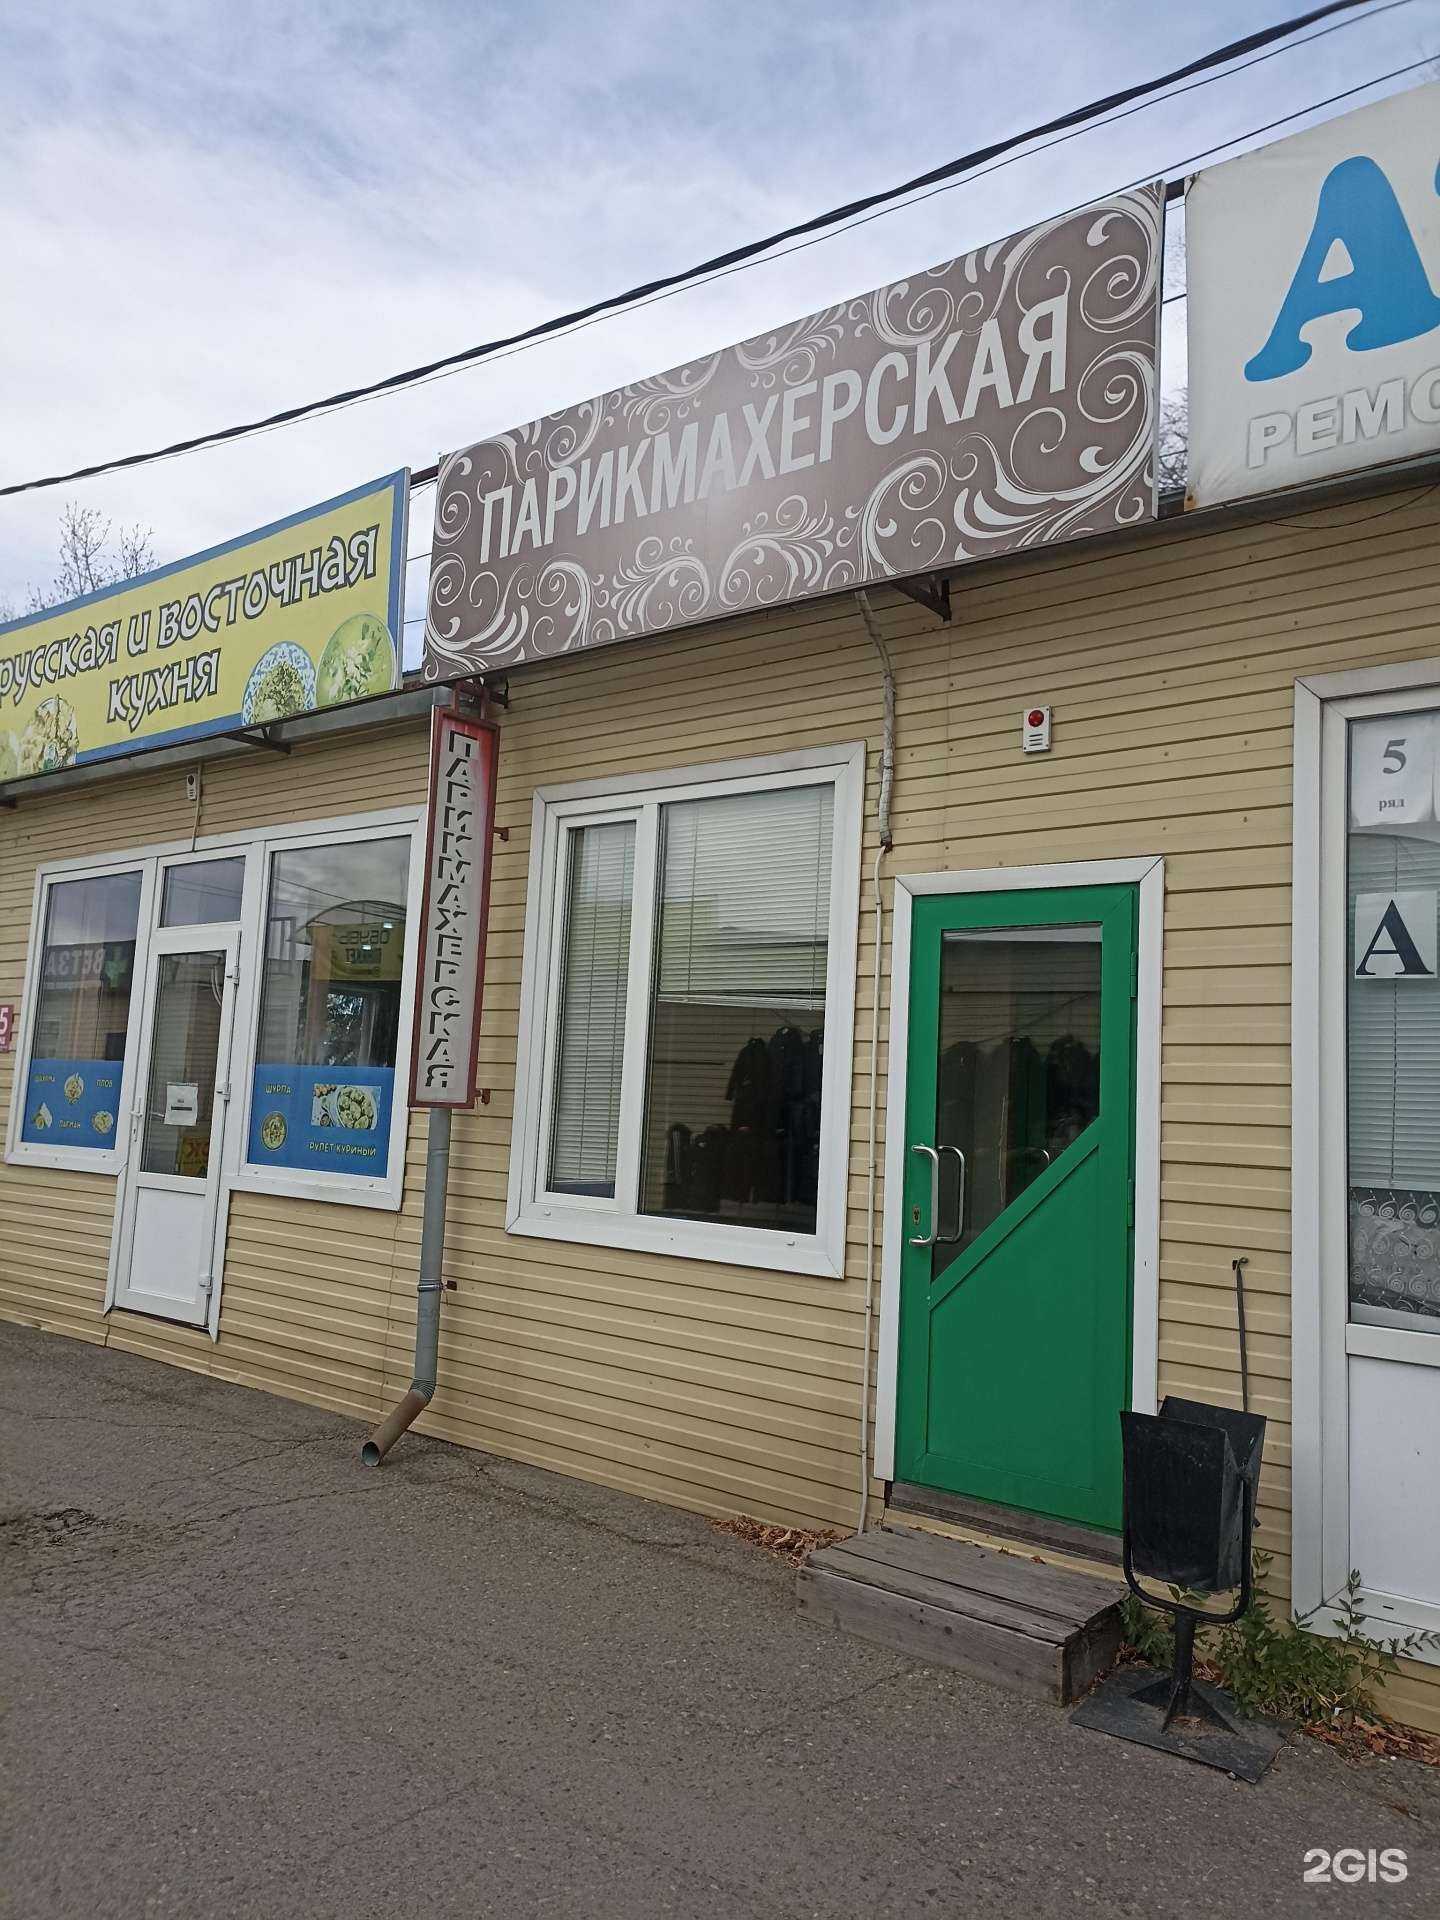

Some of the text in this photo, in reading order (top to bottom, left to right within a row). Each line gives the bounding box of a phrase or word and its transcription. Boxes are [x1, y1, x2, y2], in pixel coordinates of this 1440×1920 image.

[479, 295, 1069, 565] ПАРИКМАХЕРСКАЯ
[126, 609, 152, 659] и
[157, 523, 381, 650] восточная
[106, 647, 221, 733] кухня
[1382, 738, 1408, 775] 5
[425, 729, 480, 1089] ПАРИКМАХЕРСКАЯ
[1355, 898, 1436, 976] А
